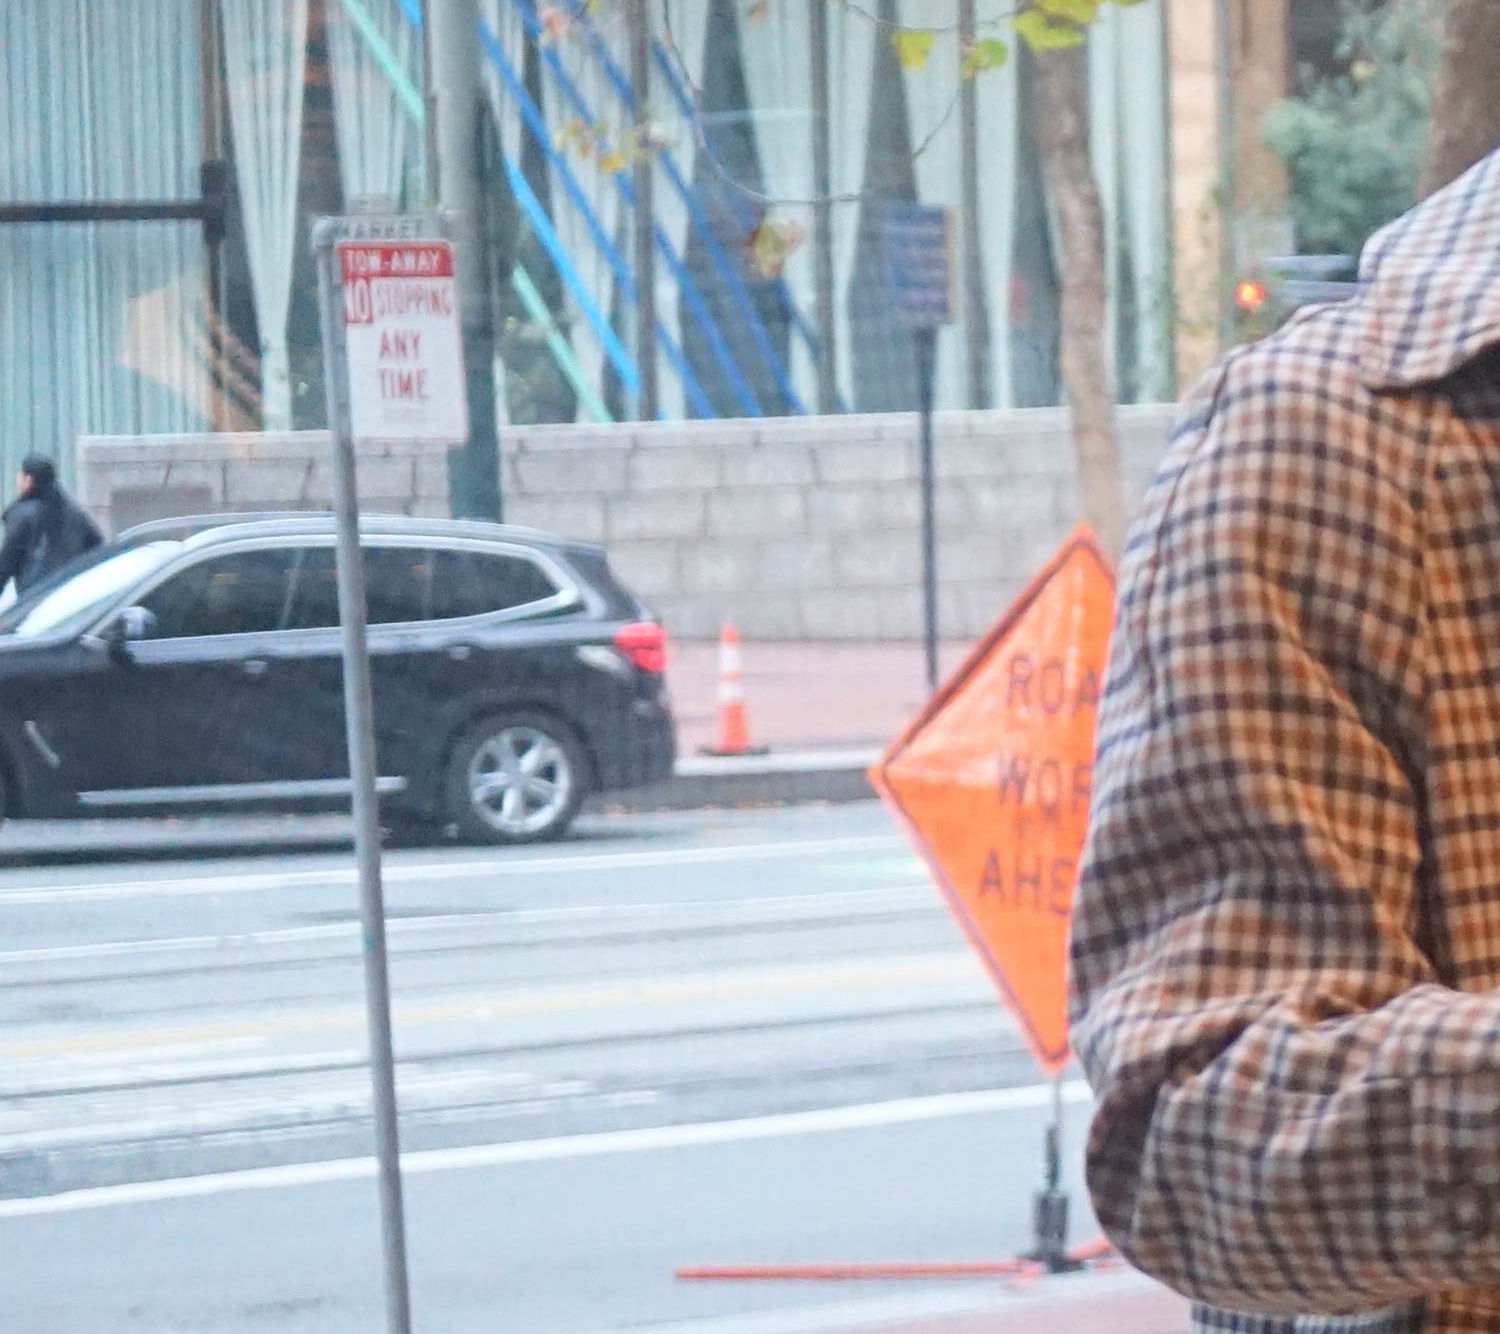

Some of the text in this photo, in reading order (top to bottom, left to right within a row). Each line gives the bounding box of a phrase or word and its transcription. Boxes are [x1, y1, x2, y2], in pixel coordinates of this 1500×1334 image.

[346, 249, 441, 273] TOW-AWAY
[376, 281, 453, 317] STOPPING
[378, 328, 421, 359] ANY
[378, 367, 429, 399] TIME
[1008, 653, 1098, 715] ROA
[978, 847, 1076, 916] AHE
